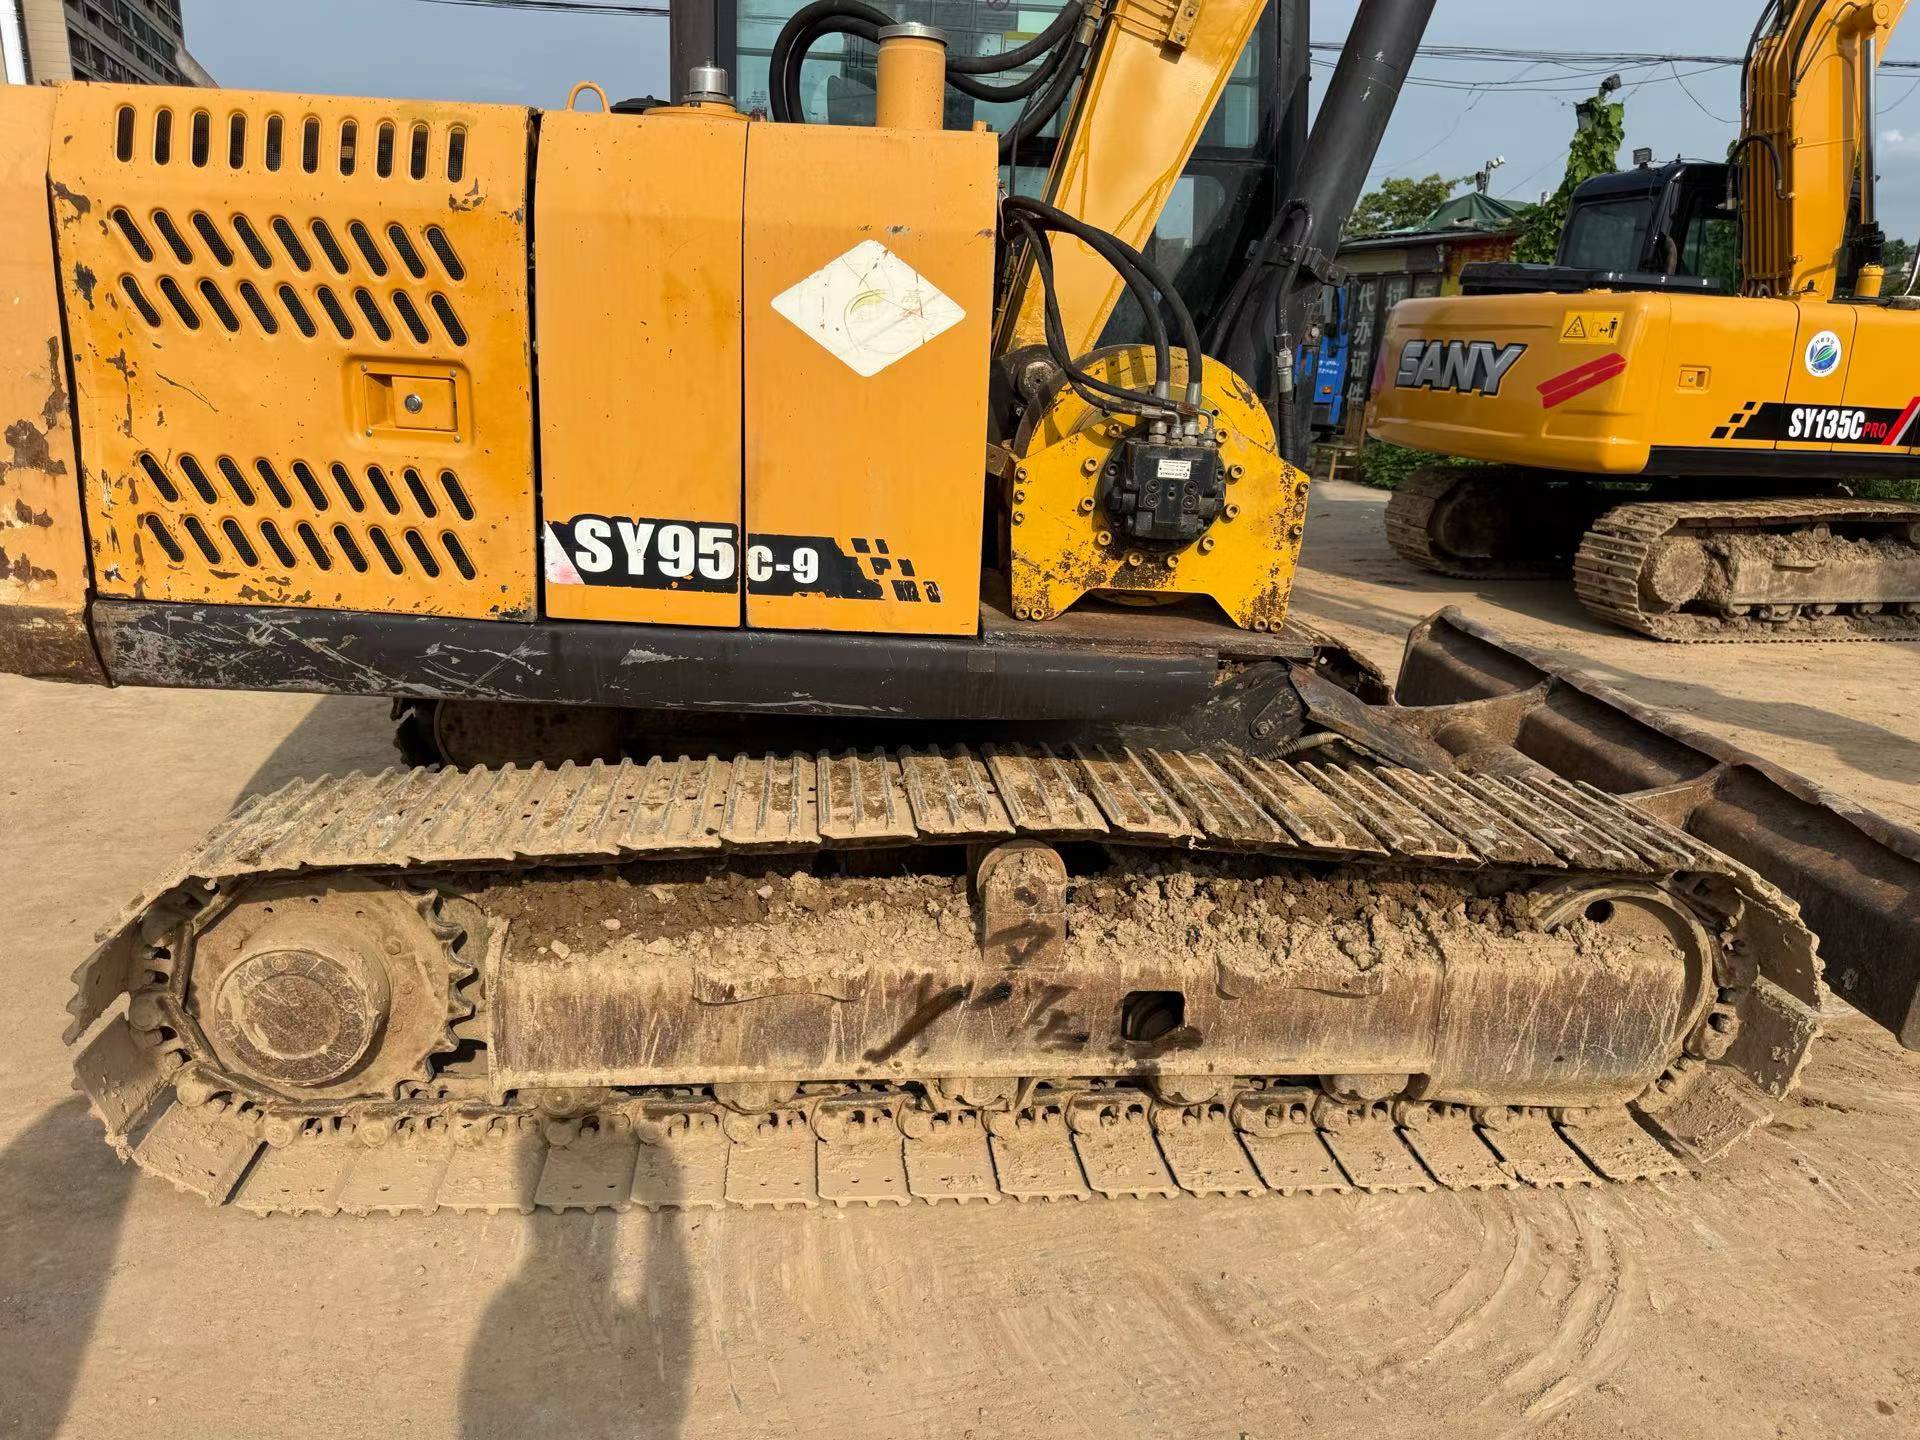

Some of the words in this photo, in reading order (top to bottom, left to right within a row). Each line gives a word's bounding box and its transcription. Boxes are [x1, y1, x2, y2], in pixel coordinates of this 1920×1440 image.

[1346, 283, 1376, 406] 代办证件
[1395, 340, 1527, 395] SANY
[1788, 408, 1865, 440] SY135C
[1862, 422, 1887, 438] PRO
